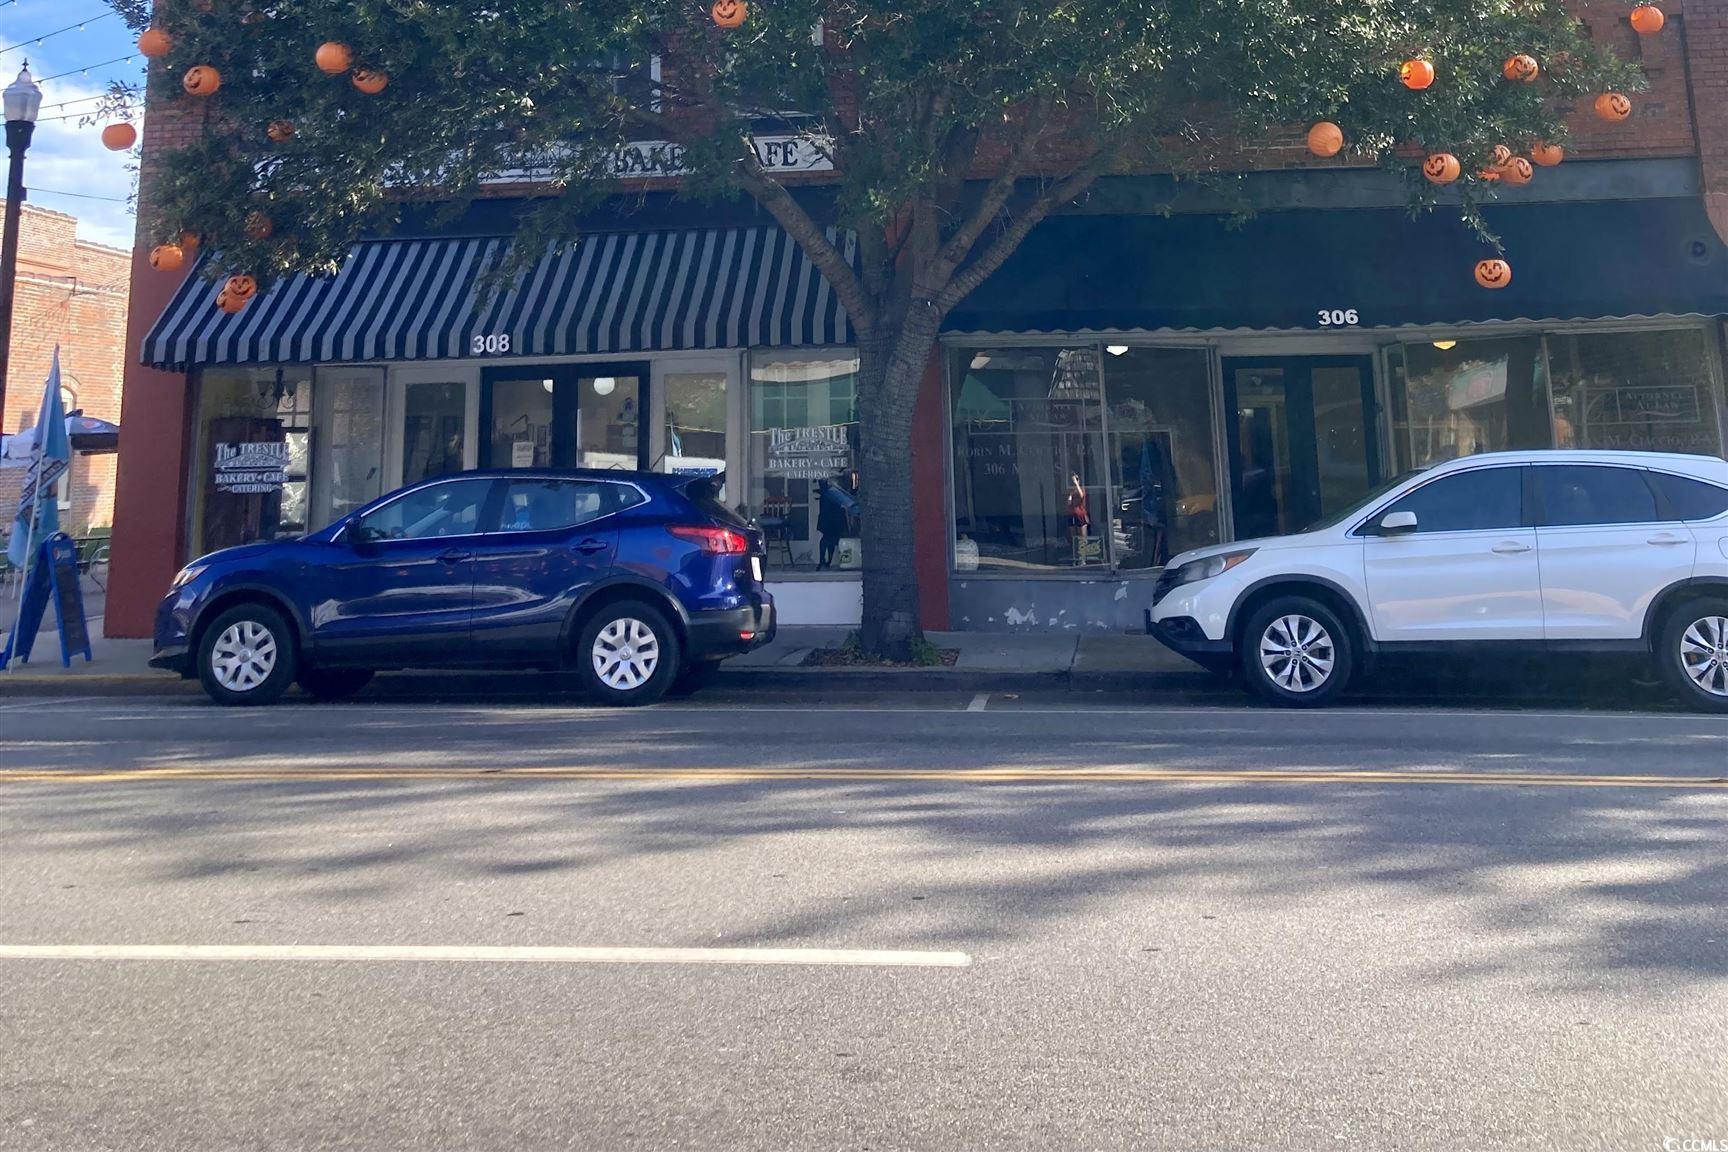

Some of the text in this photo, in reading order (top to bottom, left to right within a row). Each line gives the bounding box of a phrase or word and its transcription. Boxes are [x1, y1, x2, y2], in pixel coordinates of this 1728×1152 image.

[1318, 308, 1359, 325] 306
[473, 333, 510, 353] 308
[769, 426, 848, 447] The TRESTLE
[216, 442, 289, 462] The TRESTLE
[769, 457, 848, 469] BAKERY CAFE
[984, 463, 1005, 475] 306
[215, 472, 289, 484] BAKERY CAFE
[787, 470, 829, 479] CATERING
[232, 483, 272, 494] CATERING
